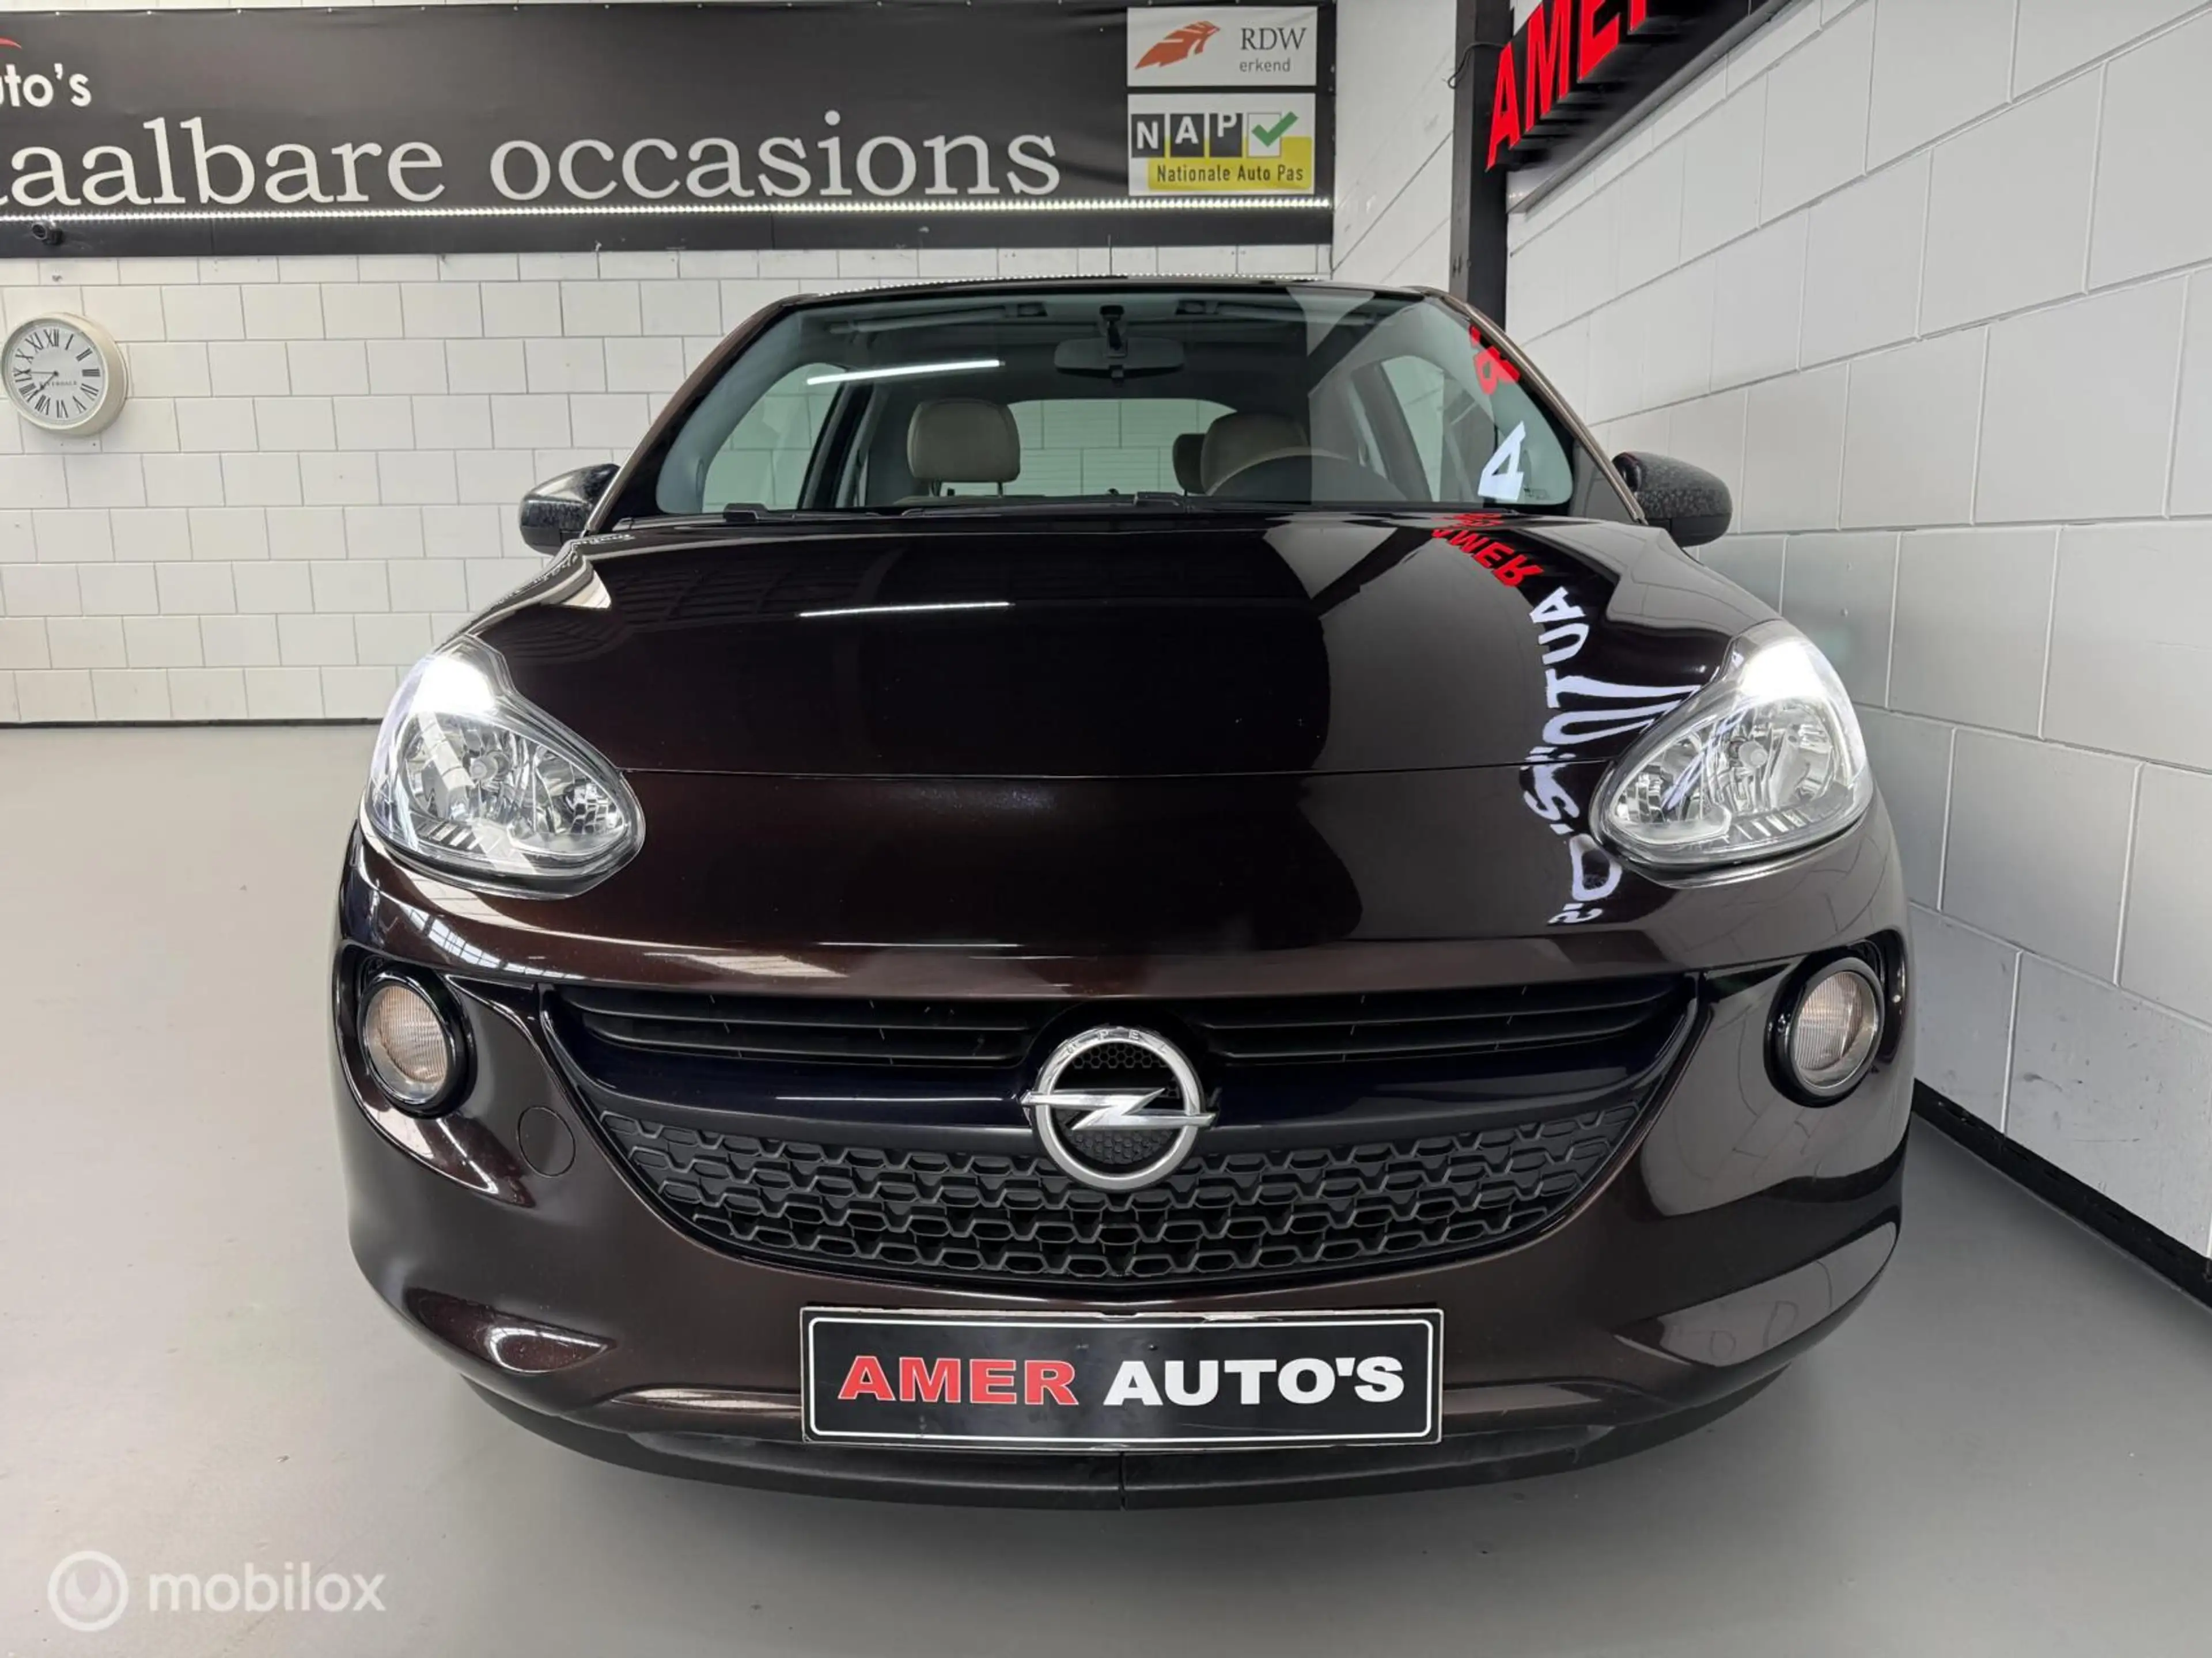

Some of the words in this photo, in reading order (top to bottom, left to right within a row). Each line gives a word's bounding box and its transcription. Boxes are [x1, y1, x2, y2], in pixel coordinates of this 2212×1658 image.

[1241, 27, 1307, 50] RDW
[0, 63, 92, 107] to's
[1239, 58, 1290, 73] erkend
[1486, 0, 1646, 170] AME
[1137, 113, 1237, 149] NAP
[0, 116, 445, 206] aalbare
[490, 110, 1060, 201] occasions
[1157, 164, 1230, 182] Nationale
[1237, 164, 1271, 181] Auto
[1277, 164, 1304, 181] Pas
[838, 1356, 1079, 1406] AMER
[1103, 1356, 1404, 1406] AUTO'S
